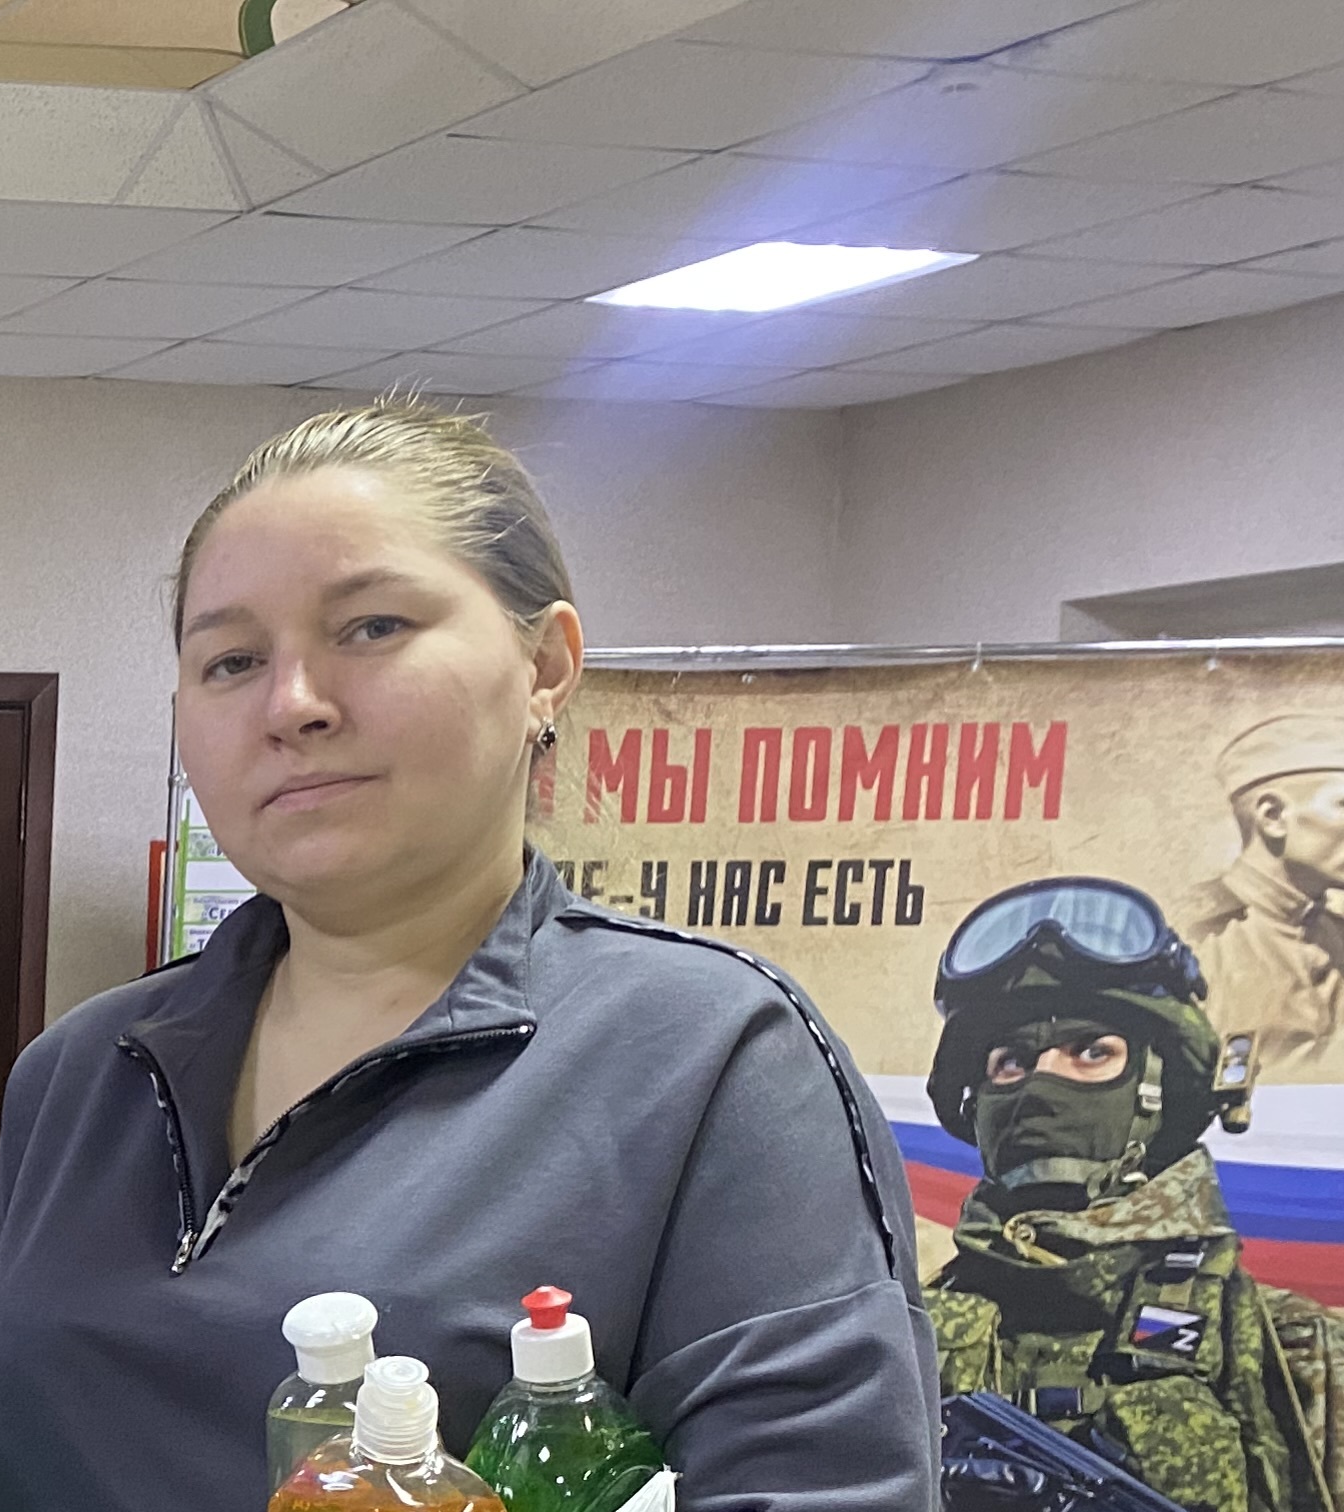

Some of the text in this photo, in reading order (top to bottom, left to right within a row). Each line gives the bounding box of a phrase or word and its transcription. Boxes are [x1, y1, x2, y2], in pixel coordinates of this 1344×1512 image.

[583, 728, 712, 824] МЫ
[738, 721, 1068, 823] ПОМНИМ
[687, 860, 786, 926] НАС
[802, 859, 925, 926] ЕСТЬ
